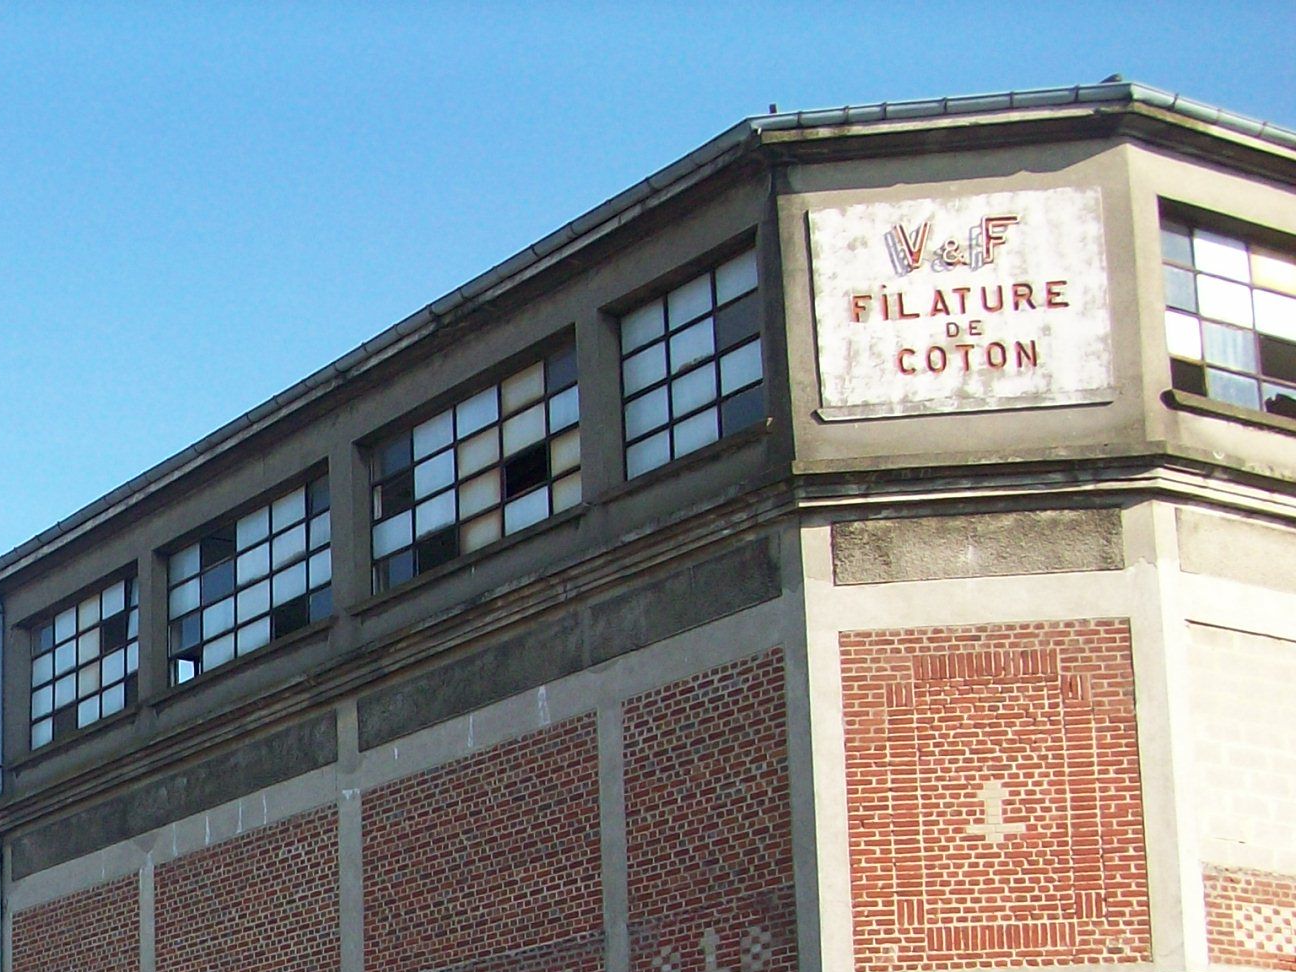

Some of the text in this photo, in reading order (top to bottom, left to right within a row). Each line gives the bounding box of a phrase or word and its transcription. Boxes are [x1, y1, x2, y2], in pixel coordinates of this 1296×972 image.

[889, 215, 1020, 272] V & F
[946, 319, 983, 338] DE
[896, 339, 1039, 376] COTON
